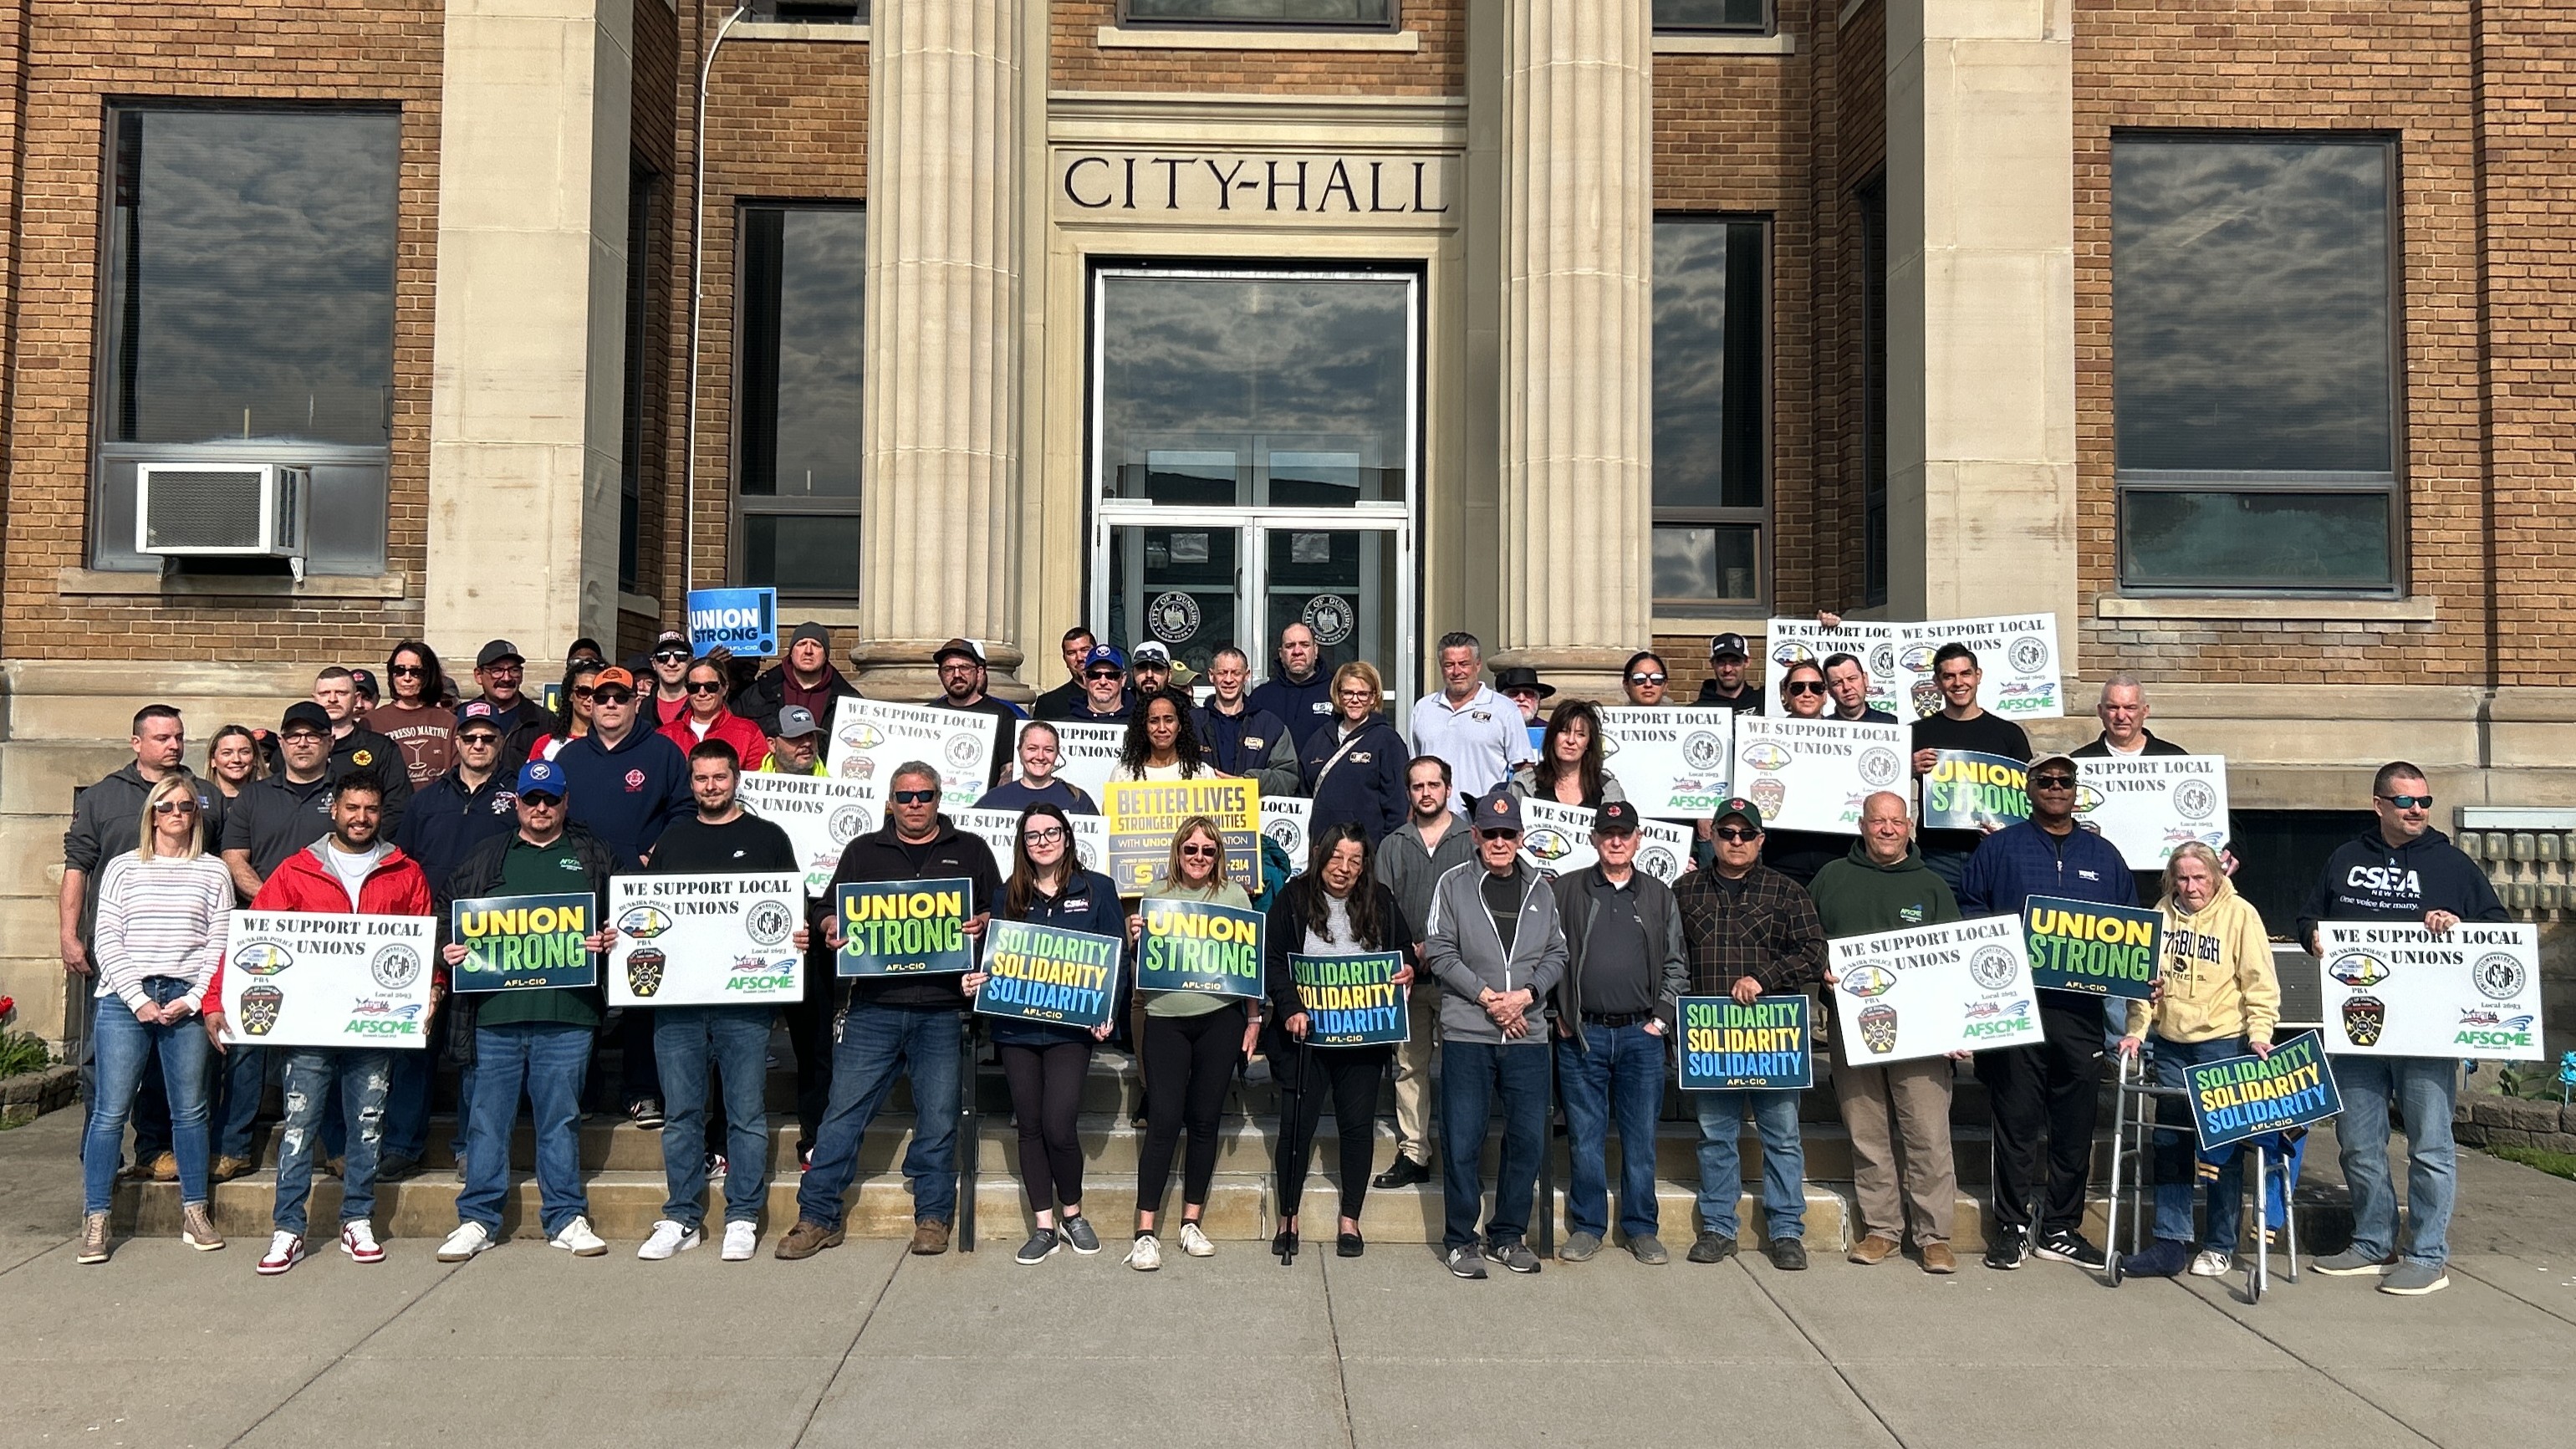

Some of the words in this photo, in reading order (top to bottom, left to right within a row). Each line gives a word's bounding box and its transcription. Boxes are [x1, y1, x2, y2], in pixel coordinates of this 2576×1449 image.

[1064, 156, 1450, 213] CITY-HALL
[1160, 594, 1172, 605] OF
[1176, 594, 1196, 627] DUNKIRK
[1314, 597, 1324, 607] OF
[691, 608, 758, 630] UNION
[695, 627, 758, 643] STRONG
[1778, 625, 1796, 635] WE
[1800, 625, 1861, 637] SUPPORT
[1865, 627, 1892, 638] LOC
[1901, 628, 1923, 640] WE
[1927, 622, 1995, 638] SUPPORT
[1999, 619, 2045, 632] LOCAL
[1816, 641, 1865, 652] UNIONS
[1996, 696, 2055, 711] AFSCME
[848, 702, 869, 715] WE
[872, 706, 939, 725] SUPPORT
[943, 714, 987, 730] LOCAL
[1603, 712, 1671, 724] SUPPORT
[1676, 713, 1722, 725] LOCAL
[417, 725, 449, 740] MARTINI
[888, 724, 941, 741] UNIONS
[1620, 730, 1677, 742] UNIONS
[1747, 722, 1770, 734] WE
[1774, 723, 1847, 738] SUPPORT
[1852, 727, 1900, 742] LOCAL
[1069, 747, 1122, 758] UNIONS
[1793, 742, 1853, 757] UNIONS
[1931, 760, 2028, 790] UNION
[2084, 762, 2162, 776] SUPPORT
[2164, 761, 2214, 774] LOCAL
[743, 778, 819, 795] SUPPORT
[825, 784, 875, 799] LOCAL
[2105, 779, 2166, 793] UNIONS
[762, 798, 824, 814] UNIONS
[1117, 788, 1189, 815] BETTER
[1192, 786, 1246, 813] LIVES
[1261, 801, 1303, 815] LOCAL
[1931, 782, 2033, 820] STRONG
[1118, 815, 1173, 832] STRONGER
[1533, 805, 1554, 820] WE
[1641, 826, 1681, 844] OCAL
[1118, 839, 1140, 848] WITH
[1142, 838, 1172, 848] UNION
[623, 883, 648, 896] WE
[653, 880, 733, 895] SUPPORT
[739, 880, 792, 894] LOCAL
[2347, 865, 2421, 893] CSEA
[674, 901, 739, 916] UNIONS
[845, 891, 962, 921] UNION
[2339, 895, 2355, 904] One
[2355, 898, 2378, 907] voice
[2379, 901, 2391, 909] for
[243, 917, 269, 931] WE
[275, 918, 360, 936] SUPPORT
[366, 921, 423, 937] LOCAL
[462, 906, 584, 937] UNION
[1147, 911, 1257, 946] UNION
[2031, 907, 2153, 947] UNION
[846, 916, 963, 957] STRONG
[1839, 942, 1865, 958] WE
[1870, 931, 1950, 954] SUPPORT
[1956, 923, 2010, 942] LOCAL
[2332, 929, 2360, 943] WE
[2366, 929, 2456, 944] SUPPORT
[2461, 931, 2523, 946] LOCAL
[297, 940, 366, 956] UNIONS
[462, 931, 586, 973] STRONG
[995, 927, 1111, 967] SOLIDARITY
[2362, 947, 2389, 959] POLICE
[885, 962, 926, 972] AFL-CIO
[1145, 936, 1257, 979] STRONG
[1894, 949, 1961, 971] UNIONS
[2028, 933, 2151, 982] STRONG
[2390, 950, 2464, 965] UNIONS
[991, 952, 1108, 991] SOLIDARITY
[1294, 959, 1395, 986] SOLIDARITY
[504, 977, 547, 987] AFL-CIO
[725, 975, 795, 990] AFSCME
[1181, 981, 1222, 990] AFL-CIO
[2065, 980, 2107, 992] AFL-CIO
[987, 976, 1104, 1015] SOLIDARITY
[1297, 983, 1395, 1010] SOLIDARITY
[1023, 1007, 1064, 1019] AFL-CIO
[1686, 1003, 1800, 1028] SOLIDARITY
[344, 1018, 418, 1034] AFSCME
[1962, 1017, 2033, 1038] AFSCME
[1687, 1028, 1801, 1054] SOLIDARITY
[2454, 1030, 2533, 1046] AFSCME
[1688, 1051, 1803, 1077] SOLIDARITY
[2195, 1040, 2313, 1091] SOLIDARITY
[1727, 1078, 1767, 1086] AFL-CIO
[2200, 1061, 2321, 1113] SOLIDARITY
[2206, 1083, 2328, 1135] SOLIDARITY
[2251, 1118, 2293, 1132] AFL-CIO
